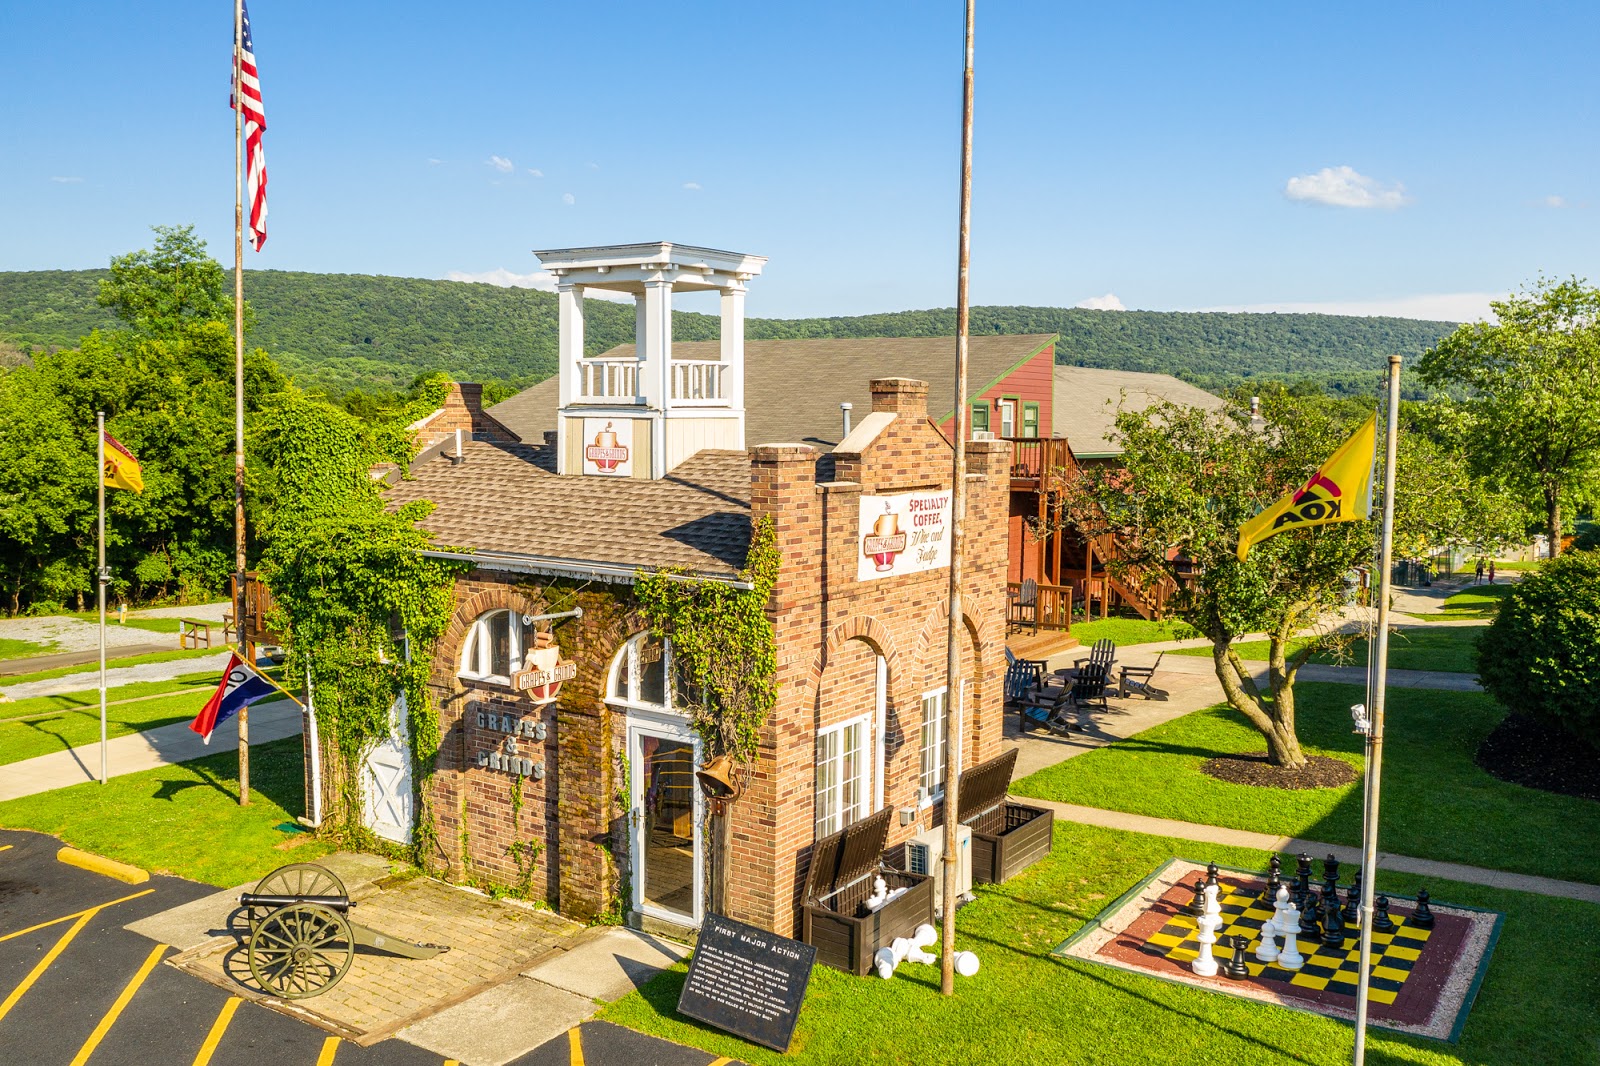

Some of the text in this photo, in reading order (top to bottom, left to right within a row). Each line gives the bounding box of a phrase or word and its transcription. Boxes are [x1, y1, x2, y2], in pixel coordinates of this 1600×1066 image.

[909, 496, 948, 512] SPECIALTY
[914, 512, 942, 527] COFFEE,
[910, 526, 944, 546] Wine and
[916, 546, 938, 565] Fudge
[521, 664, 576, 690] GRAPES & GRINDS
[477, 712, 547, 740] GRAPES
[506, 736, 518, 754] &
[478, 751, 546, 779] GRINDS
[715, 926, 799, 959] FIRST MAJOR ACTION
